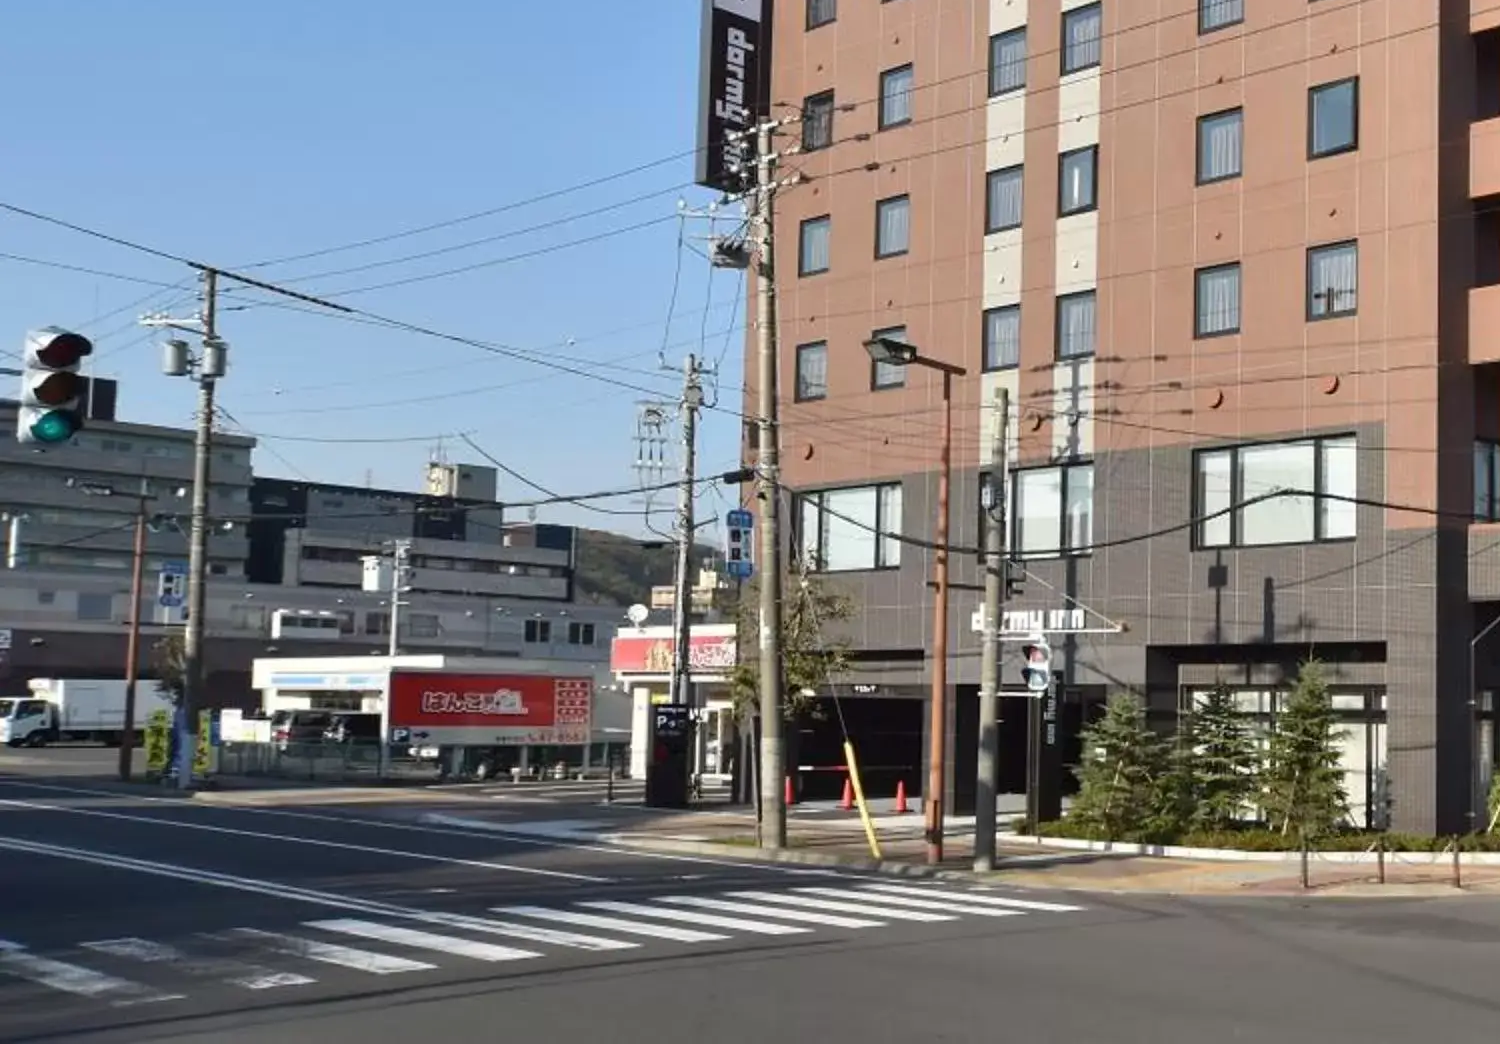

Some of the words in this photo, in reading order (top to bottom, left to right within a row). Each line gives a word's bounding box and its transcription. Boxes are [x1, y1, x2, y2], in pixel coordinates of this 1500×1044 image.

[715, 27, 755, 124] dormy
[971, 602, 1045, 632] drmy
[1049, 609, 1086, 630] inn
[657, 716, 668, 729] P
[393, 731, 409, 741] P
